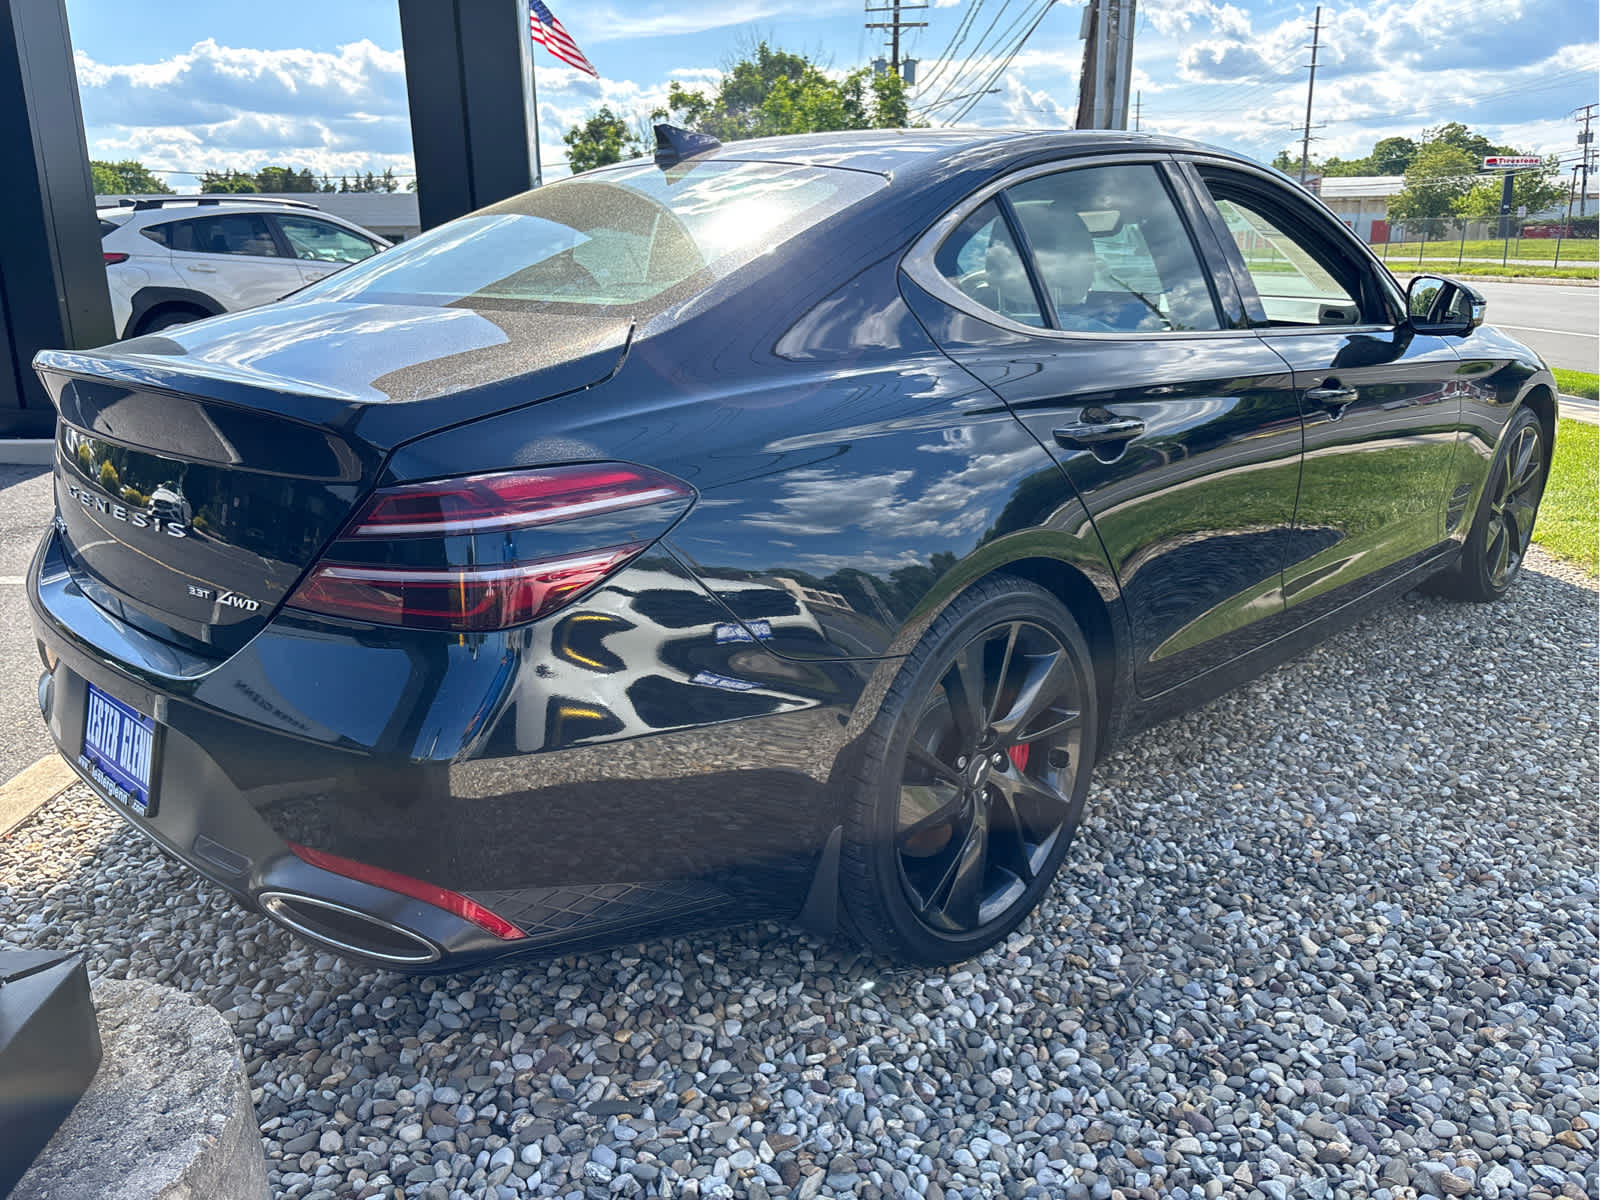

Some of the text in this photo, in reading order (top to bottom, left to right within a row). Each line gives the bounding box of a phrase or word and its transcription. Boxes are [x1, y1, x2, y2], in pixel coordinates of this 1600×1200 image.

[69, 485, 187, 538] GENESIS
[216, 591, 259, 611] 4WD
[86, 692, 153, 787] LESTER GLENN
